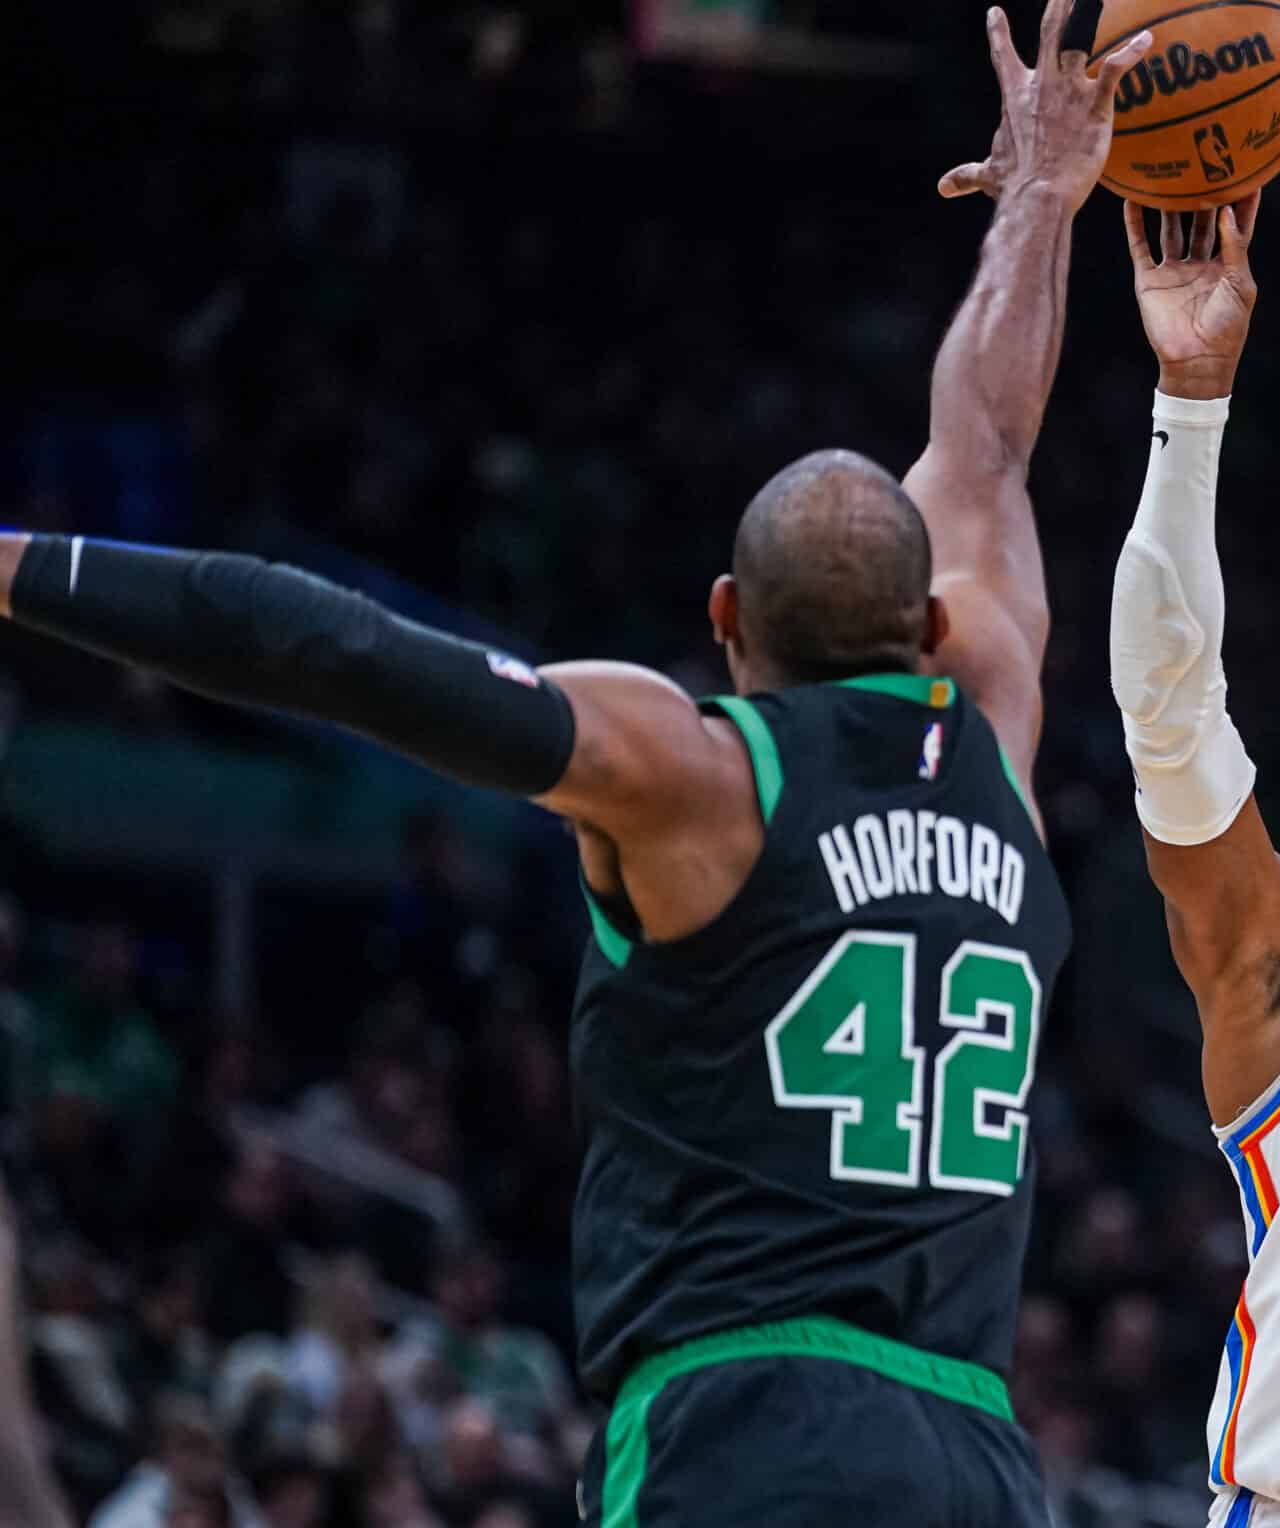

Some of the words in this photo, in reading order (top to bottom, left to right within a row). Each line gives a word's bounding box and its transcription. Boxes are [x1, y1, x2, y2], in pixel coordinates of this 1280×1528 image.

[1113, 33, 1275, 112] Wilson
[818, 810, 1025, 925] HORFORD
[764, 930, 1042, 1196] 42
